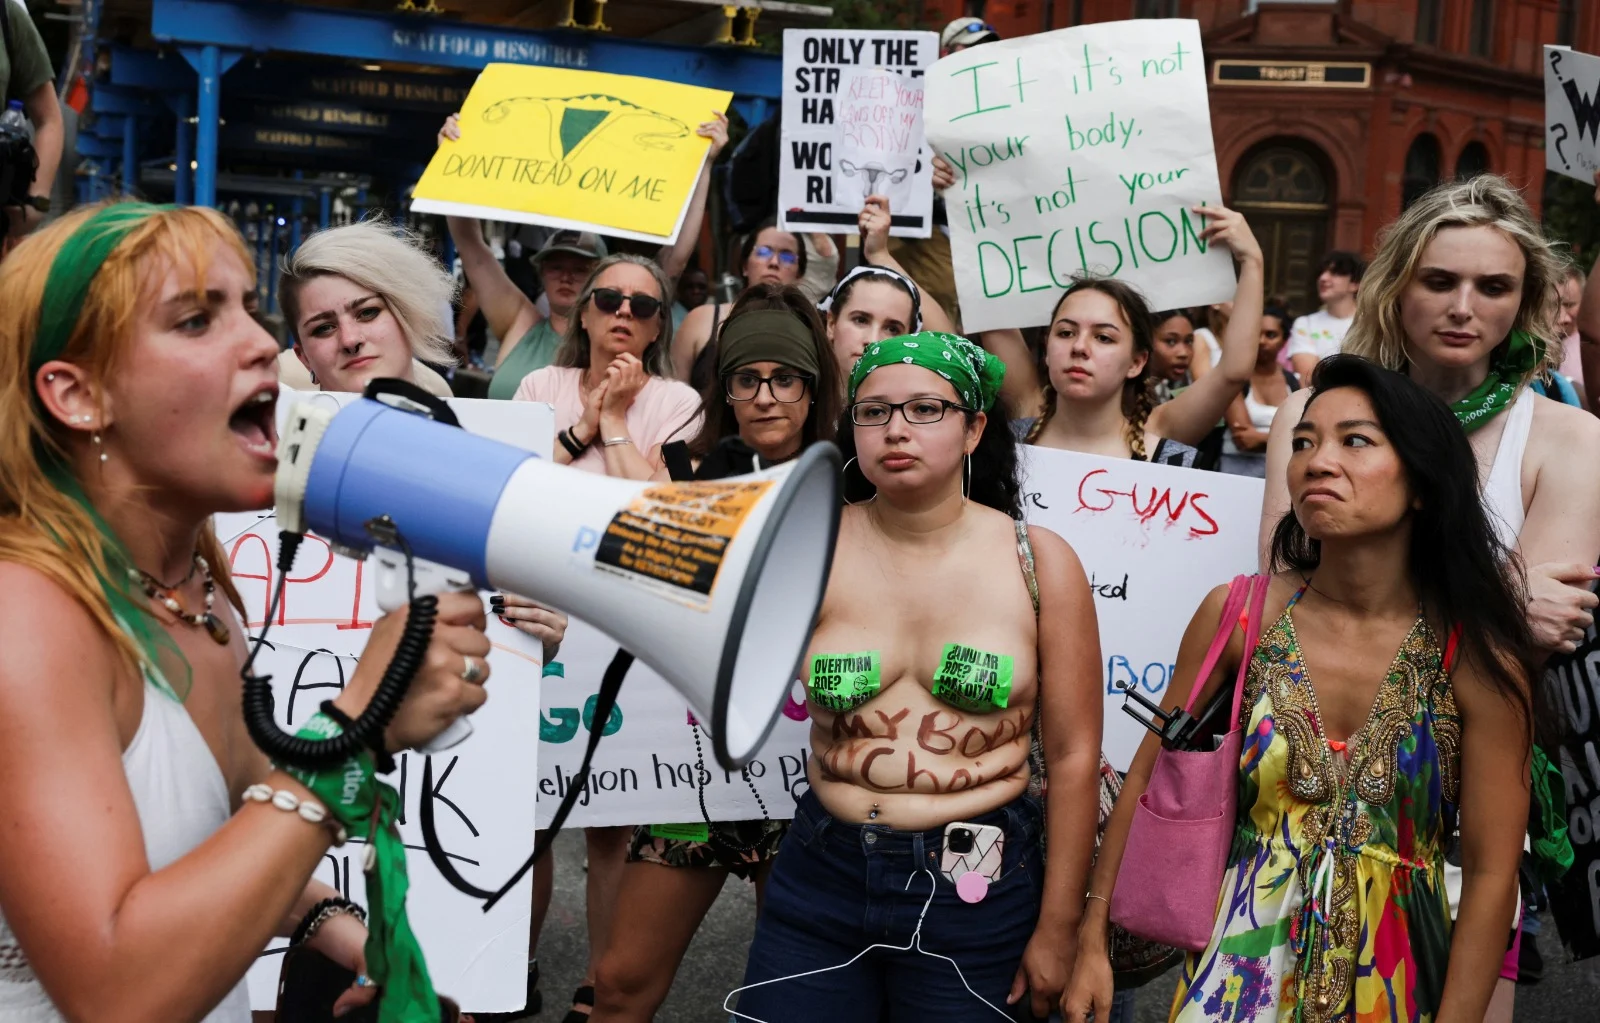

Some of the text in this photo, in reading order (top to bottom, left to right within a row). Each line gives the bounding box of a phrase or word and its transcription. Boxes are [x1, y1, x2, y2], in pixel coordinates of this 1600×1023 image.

[393, 29, 588, 67] SCAFFOLD RESOURCE
[803, 37, 919, 66] ONLY THE
[1072, 43, 1122, 94] it's
[1141, 41, 1191, 78] not
[848, 75, 924, 110] KEEP YOUR
[802, 98, 834, 125] HA
[900, 112, 917, 131] MY
[512, 157, 572, 187] TREAD
[578, 166, 616, 194] ON
[617, 175, 666, 203] ME
[945, 135, 1031, 190] your
[965, 167, 1190, 233] it's not your
[978, 201, 1207, 298] DECISION
[1023, 468, 1219, 536] re GUNS
[814, 674, 842, 691] ROE?
[815, 656, 872, 674] OVERTURN
[942, 660, 972, 679] ROE?
[832, 708, 911, 742] MY
[536, 764, 638, 807] eligion
[652, 754, 712, 790] has
[779, 748, 808, 792] pl
